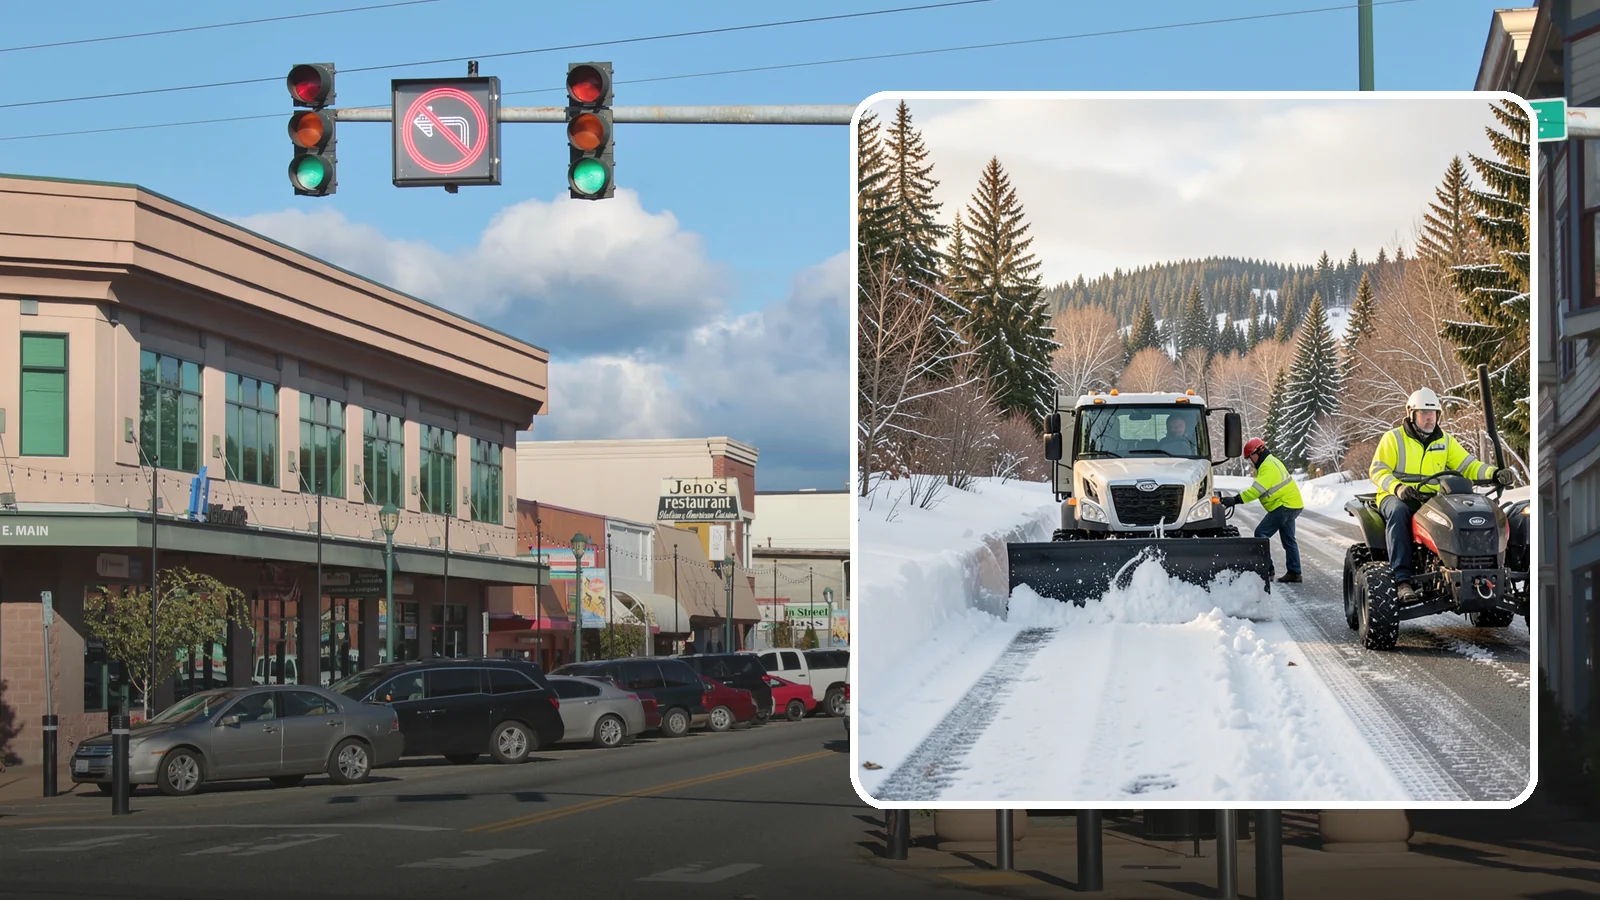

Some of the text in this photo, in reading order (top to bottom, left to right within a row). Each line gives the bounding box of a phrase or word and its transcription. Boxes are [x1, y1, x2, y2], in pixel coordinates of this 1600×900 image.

[670, 480, 727, 494] Jeno's
[665, 496, 731, 509] restaurant
[658, 510, 681, 520] Italian
[685, 509, 715, 519] American
[714, 509, 737, 519] Cuisine
[2, 525, 49, 537] E. MAIN
[797, 607, 828, 617] Street
